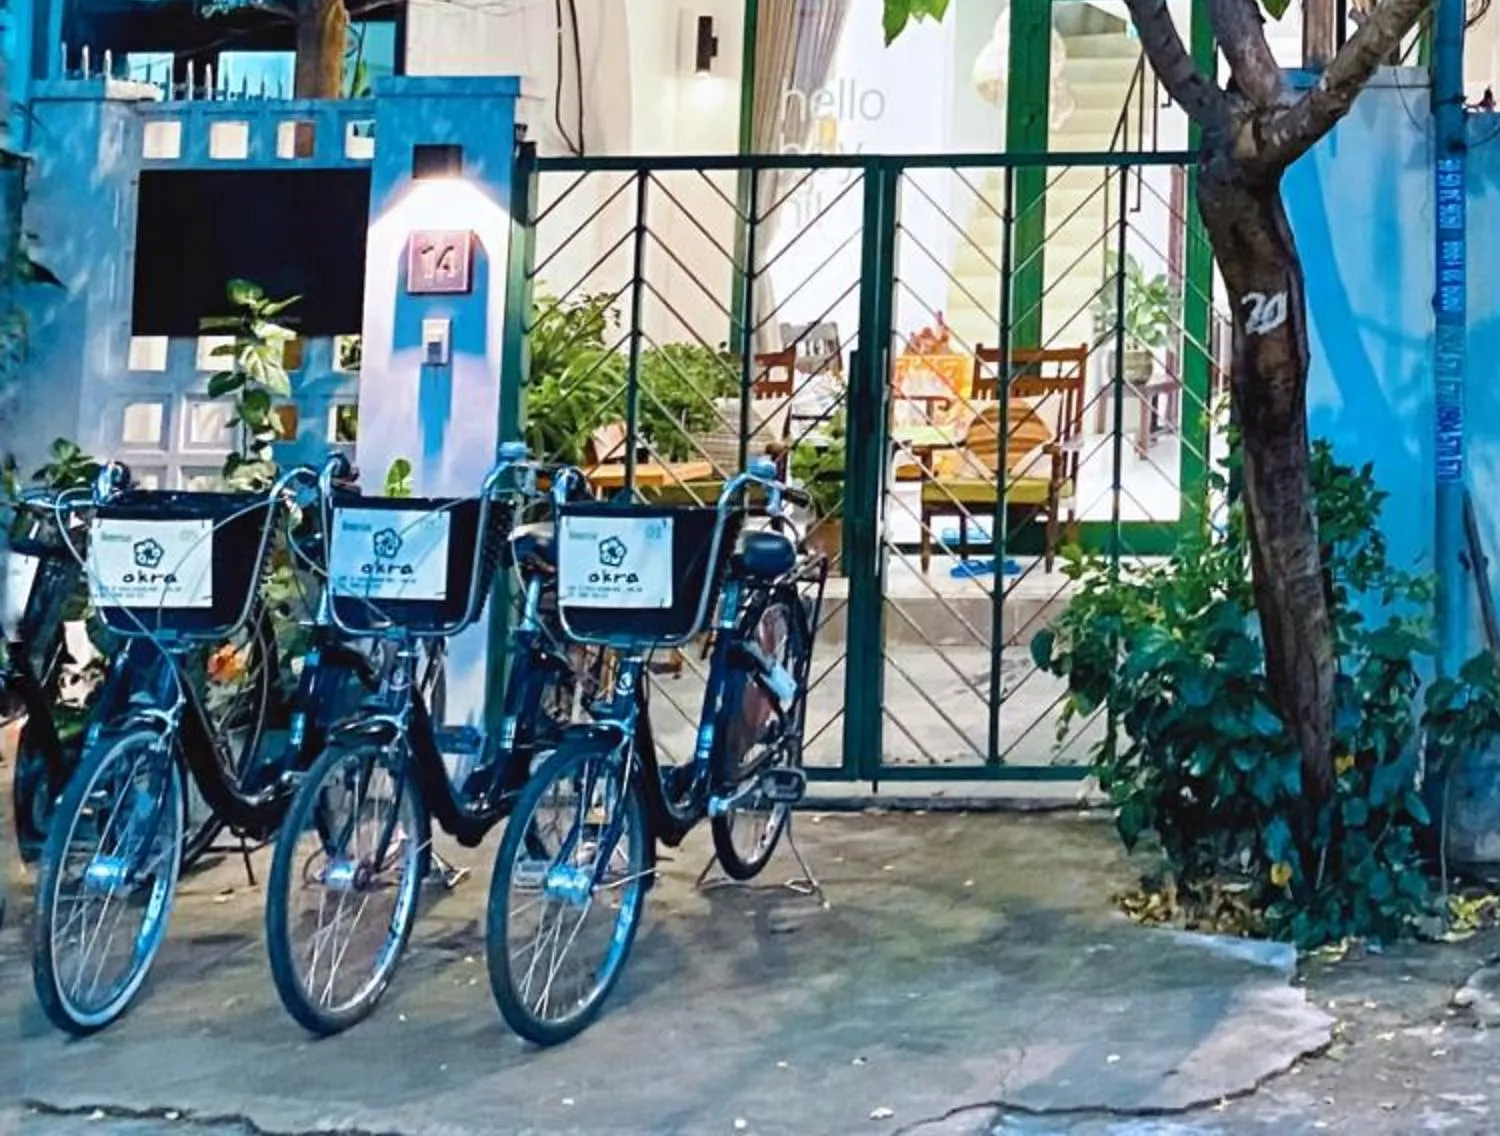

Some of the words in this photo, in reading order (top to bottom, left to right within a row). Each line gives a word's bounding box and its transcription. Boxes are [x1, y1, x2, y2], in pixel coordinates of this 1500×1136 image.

[781, 79, 886, 121] hello
[361, 560, 413, 574] okra
[122, 569, 177, 583] okra
[588, 569, 639, 583] okra
